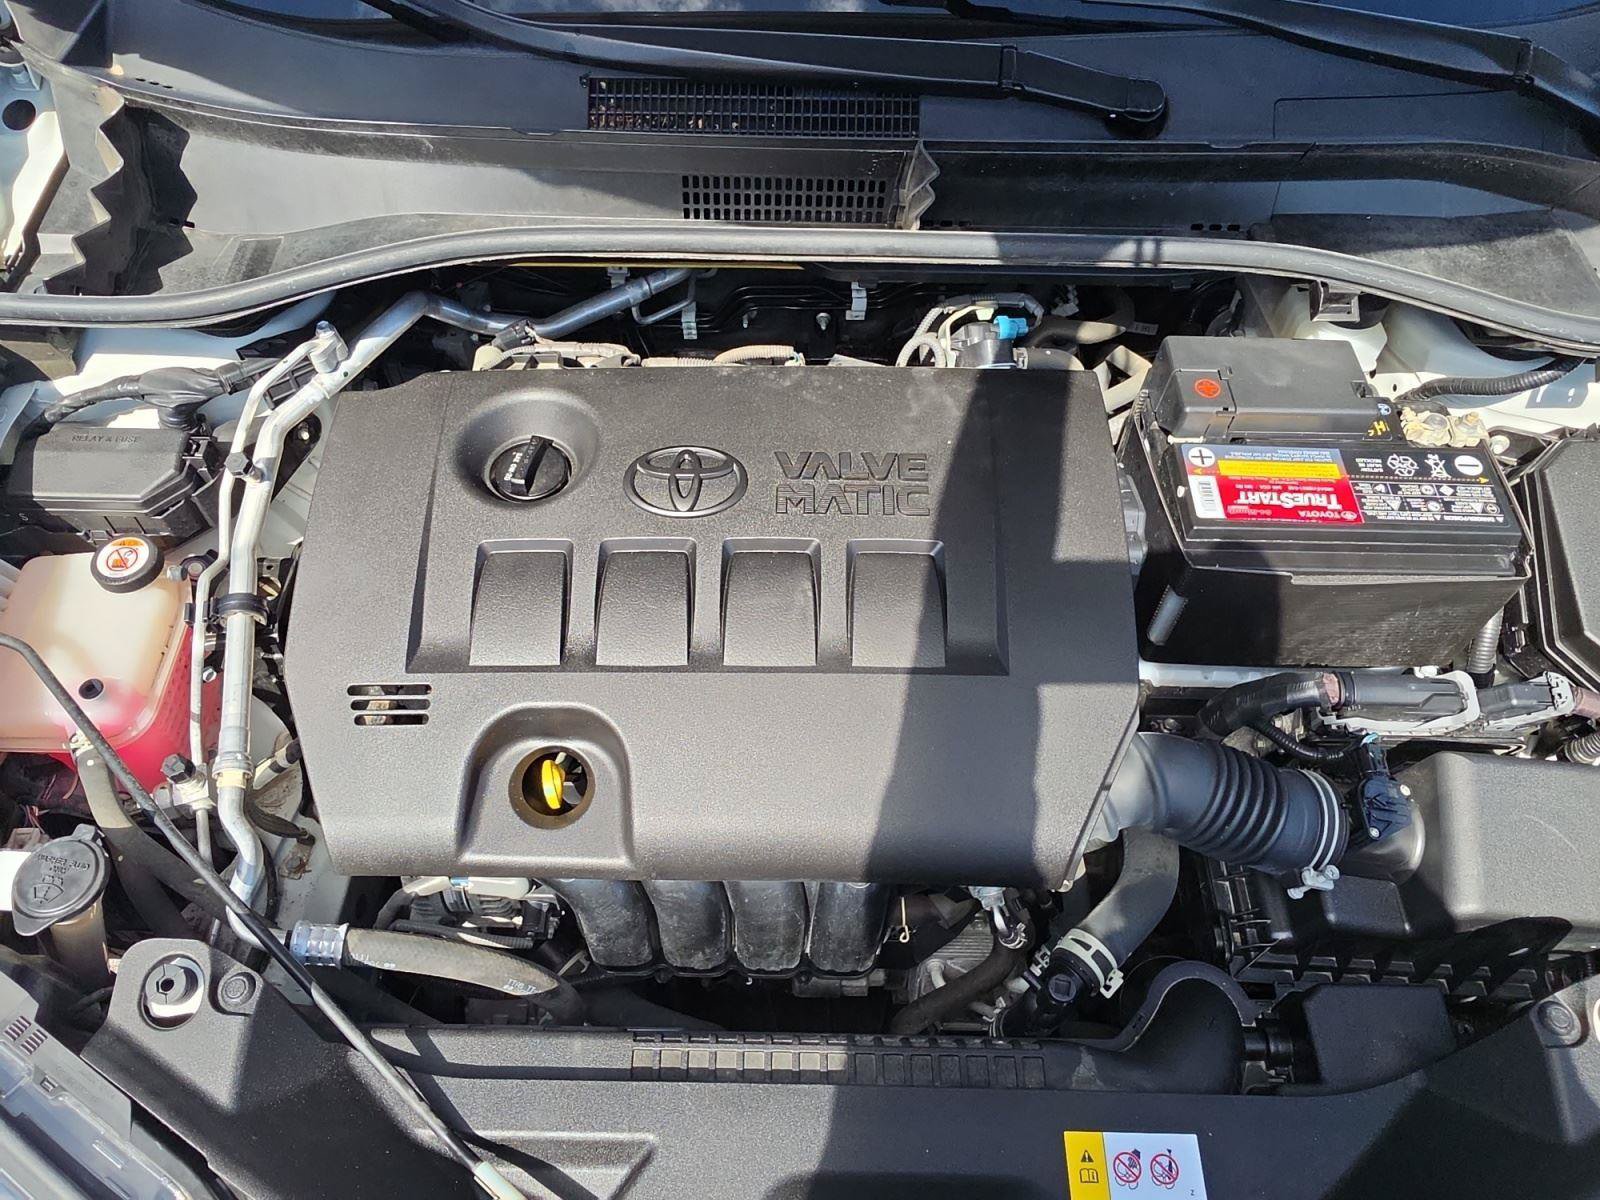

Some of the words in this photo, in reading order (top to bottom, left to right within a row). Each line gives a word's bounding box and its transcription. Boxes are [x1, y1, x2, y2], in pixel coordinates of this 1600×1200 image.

[774, 451, 929, 481] VALVE
[775, 484, 930, 517] MATIC
[1297, 510, 1342, 519] TOYOTA
